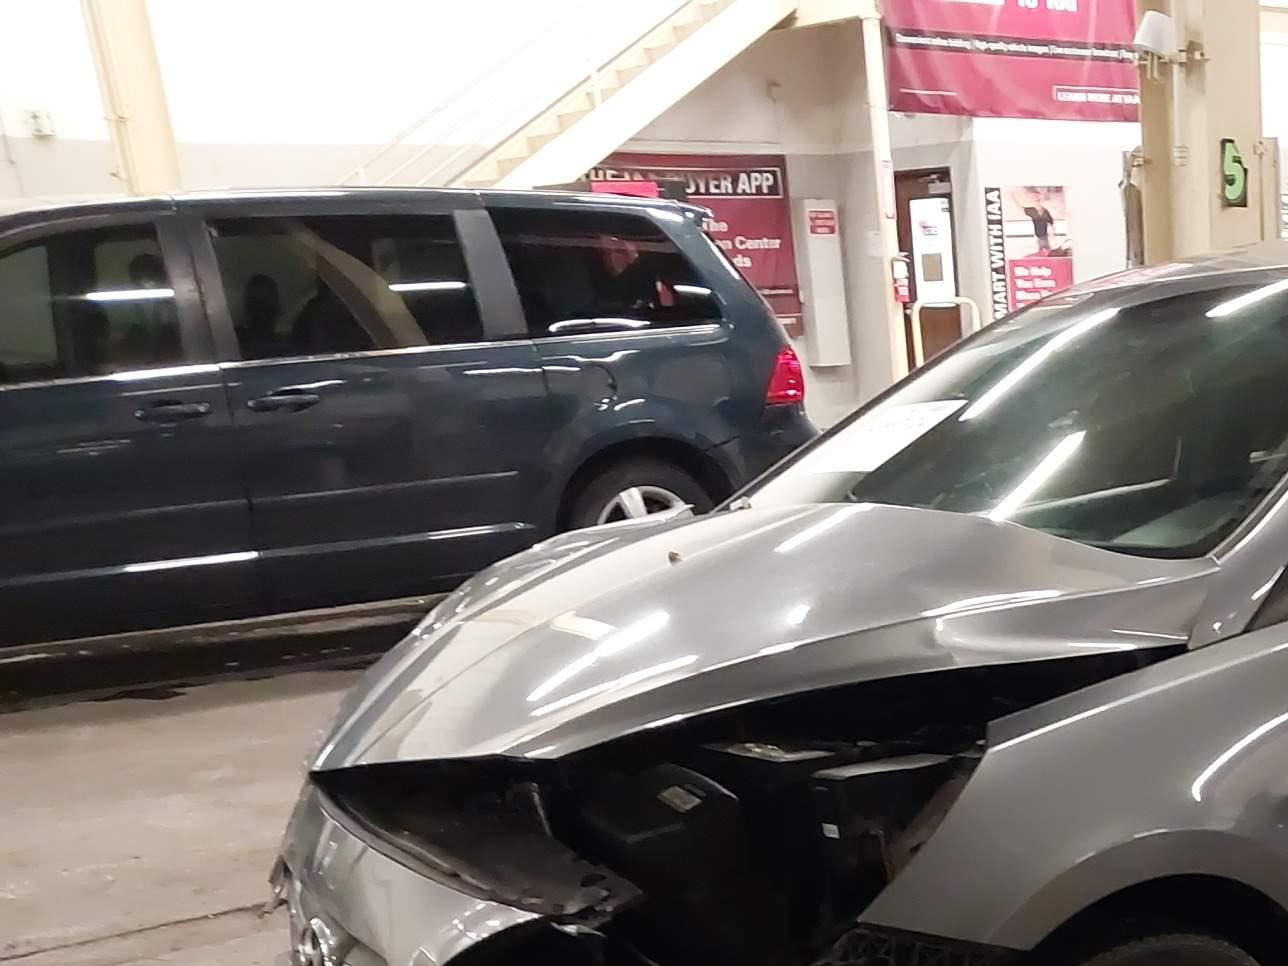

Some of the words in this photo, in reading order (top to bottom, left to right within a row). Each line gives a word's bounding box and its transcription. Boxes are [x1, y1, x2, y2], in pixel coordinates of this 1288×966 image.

[736, 172, 774, 194] APP
[1223, 141, 1245, 200] 5
[985, 190, 1002, 220] IAA
[734, 235, 781, 249] Center
[987, 224, 1006, 269] WITH
[991, 271, 1009, 320] MART
